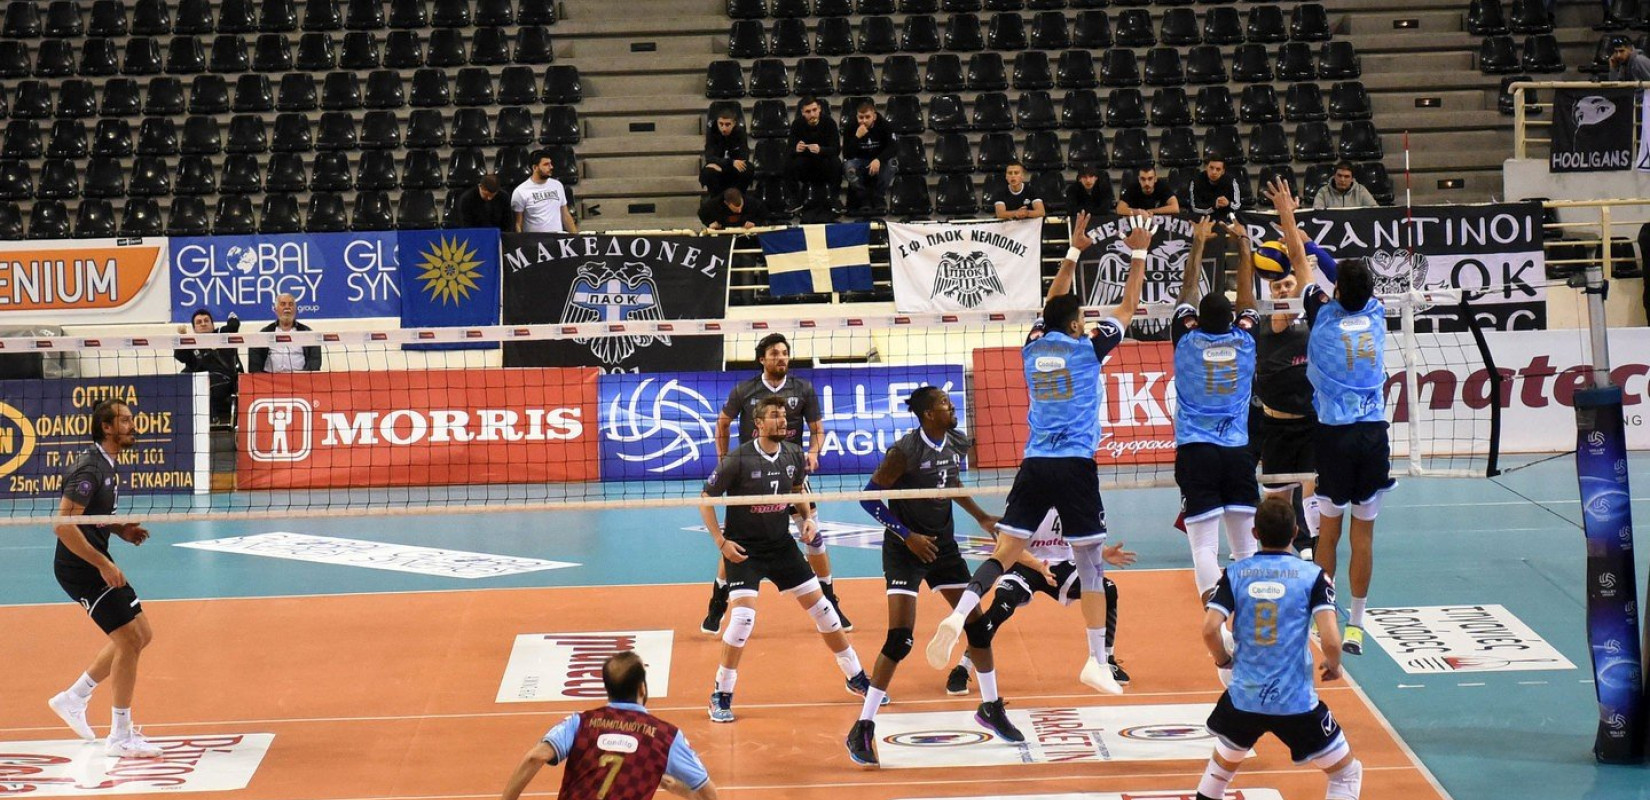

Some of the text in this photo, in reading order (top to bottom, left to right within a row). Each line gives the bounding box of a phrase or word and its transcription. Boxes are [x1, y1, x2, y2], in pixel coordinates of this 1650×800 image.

[1552, 150, 1630, 169] HOOLIGANS
[176, 241, 323, 277] GLOBAL
[344, 239, 400, 272] GL
[504, 236, 725, 279] ΜΑΚΕΔΟΝΕΣ
[926, 229, 964, 247] ΠΑΟΚ
[970, 229, 1029, 258] ΝΕΑΠΟΛΗΣ
[949, 268, 983, 278] ΠΑΟΚ
[180, 274, 323, 307] SYNERGY
[589, 294, 638, 305] ΠΑΟΚ
[1340, 332, 1376, 372] 14
[1032, 368, 1074, 401] 20
[1203, 361, 1238, 396] 13
[1383, 355, 1650, 423] matec
[72, 385, 138, 409] ΟΠΤΙΚΑ
[321, 407, 583, 446] MORRIS
[143, 448, 165, 465] 101
[9, 475, 40, 494] 25ης
[131, 471, 193, 489] ΕΥΚΑΡΠΙΑ
[770, 480, 779, 495] 7
[936, 469, 948, 489] 3
[1051, 515, 1061, 534] 4
[1254, 601, 1278, 647] 8
[1365, 608, 1419, 616] &
[597, 754, 625, 800] 7
